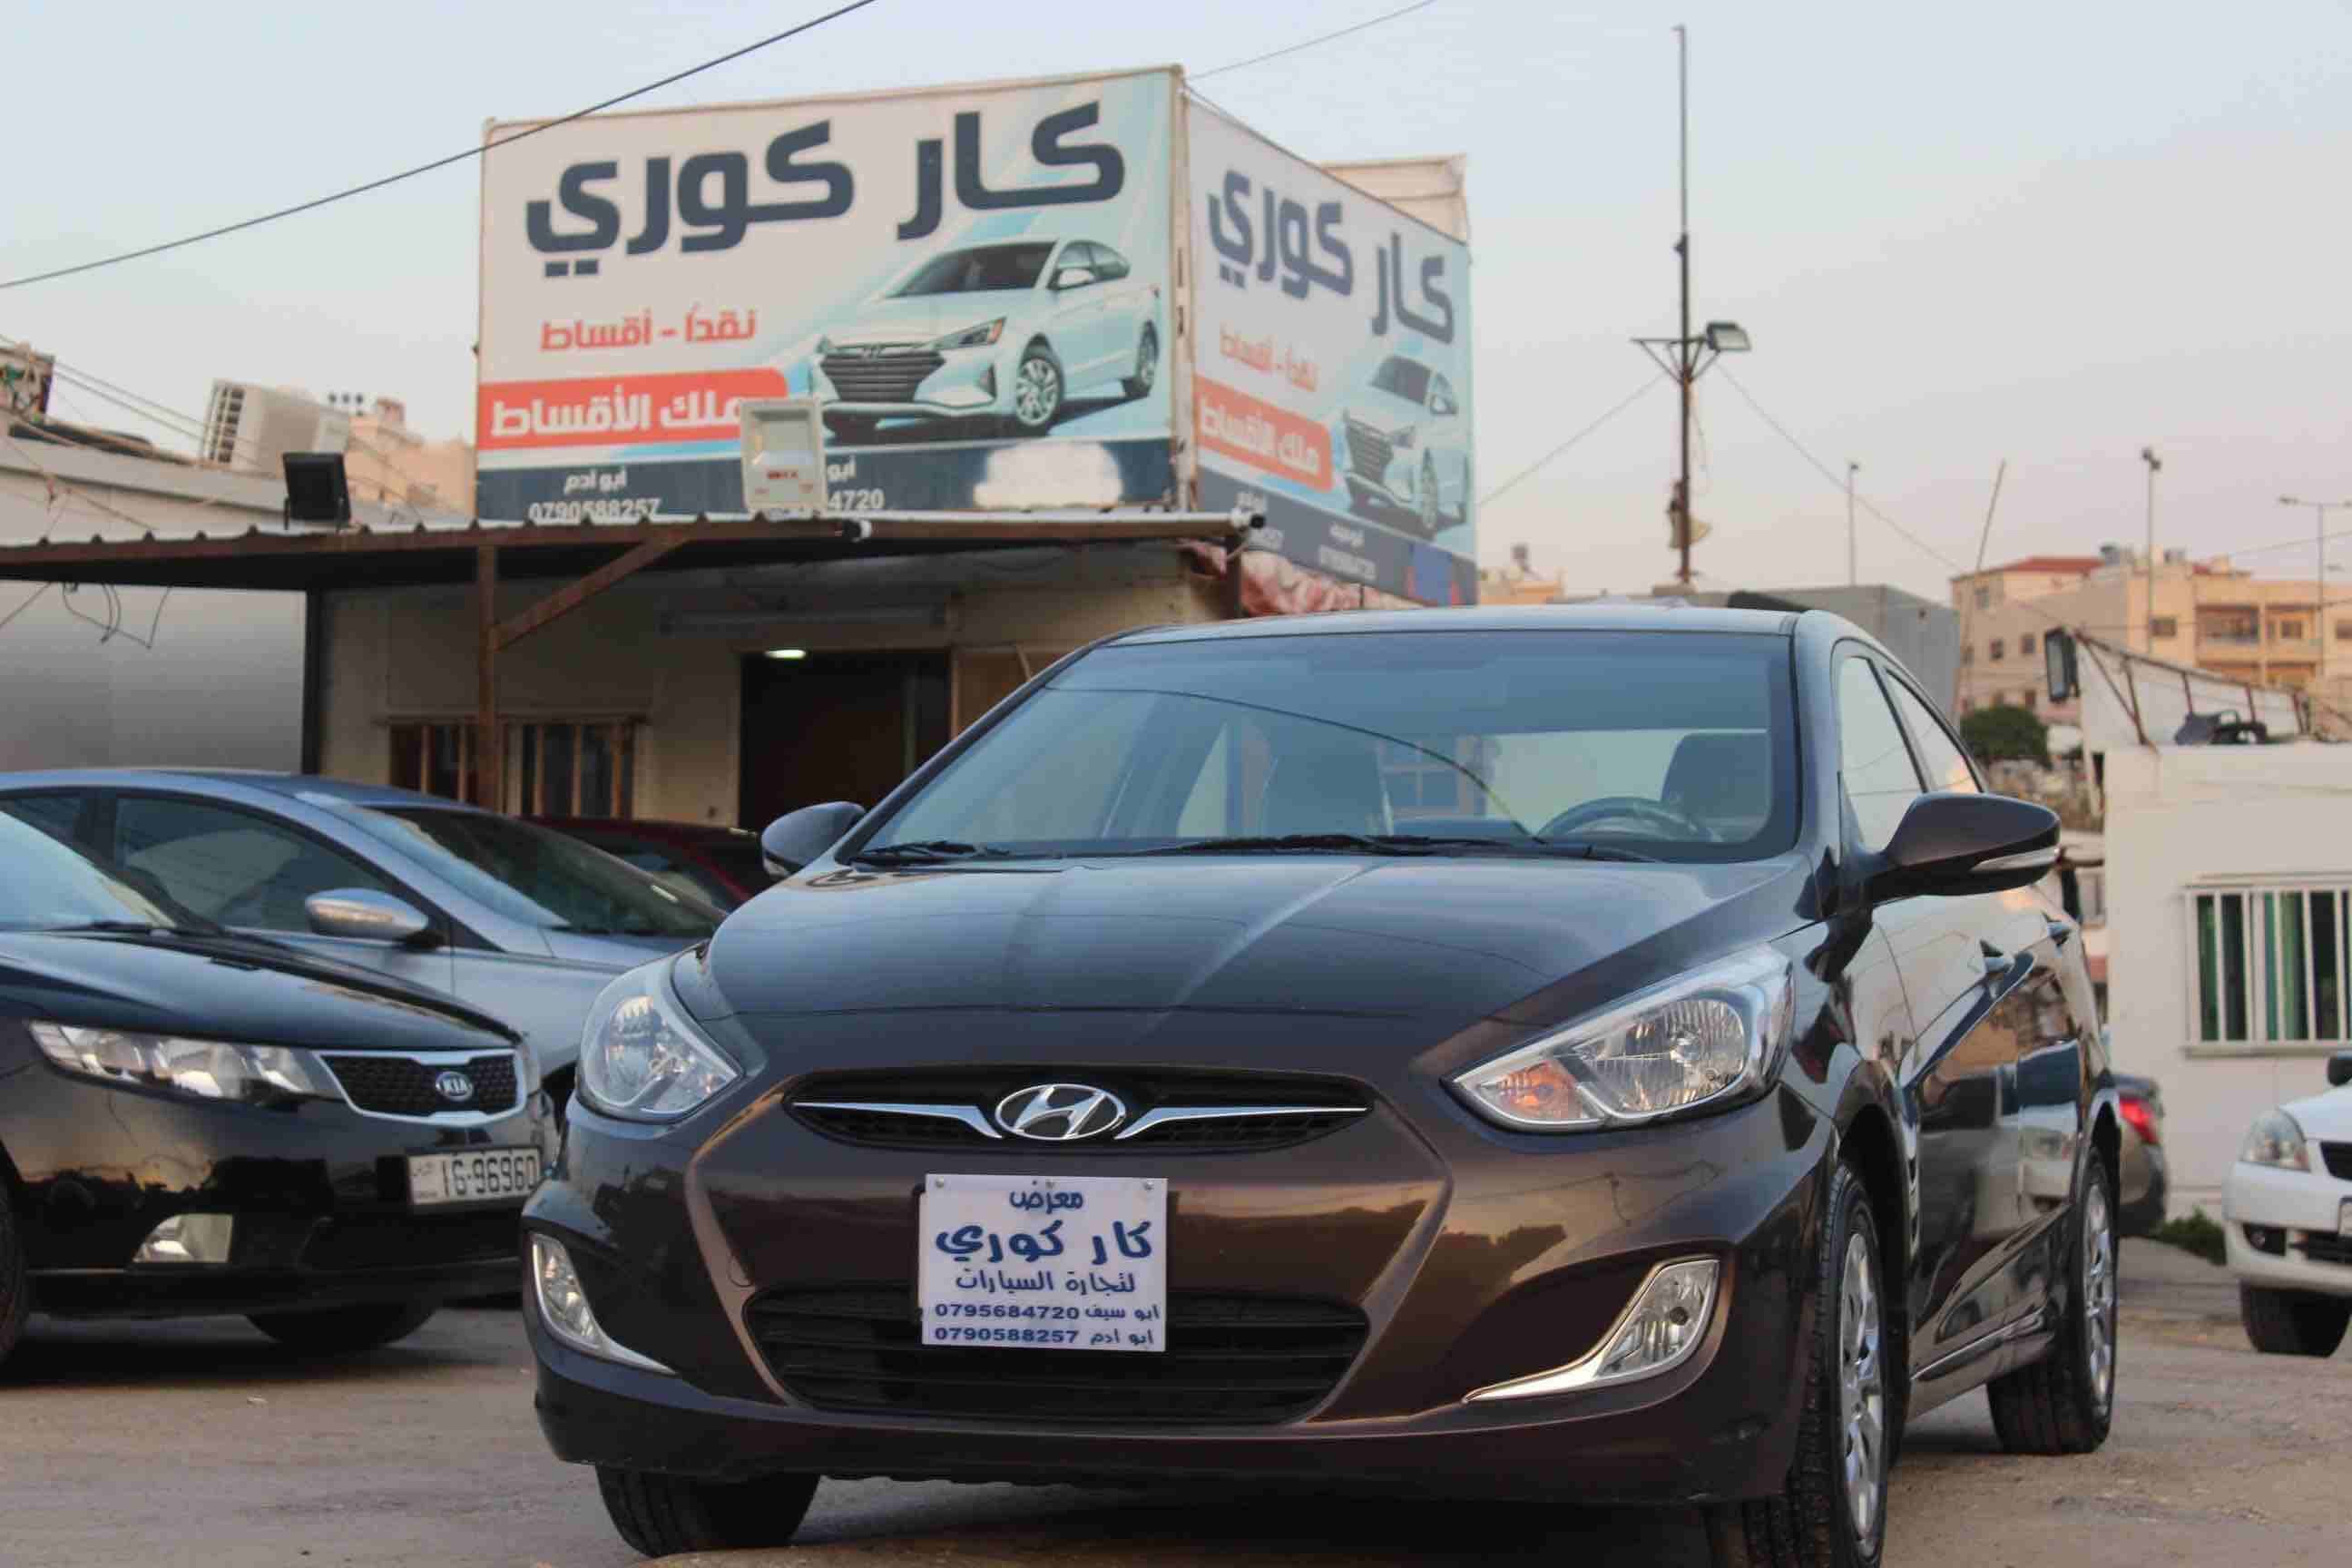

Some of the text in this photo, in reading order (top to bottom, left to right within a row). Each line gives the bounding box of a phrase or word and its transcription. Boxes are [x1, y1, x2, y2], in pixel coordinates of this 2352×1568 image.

[525, 102, 1125, 278] كار كوري
[1208, 170, 1455, 345] كار كوري
[490, 384, 652, 437] الأقساط
[1009, 1180, 1084, 1215] معرض
[936, 1219, 1152, 1266] كار كوري
[956, 1269, 1136, 1298] لتجارة السيارات
[935, 1303, 1080, 1321] 0795684720
[1084, 1305, 1126, 1322] سيف
[935, 1327, 1080, 1344] 0790588257
